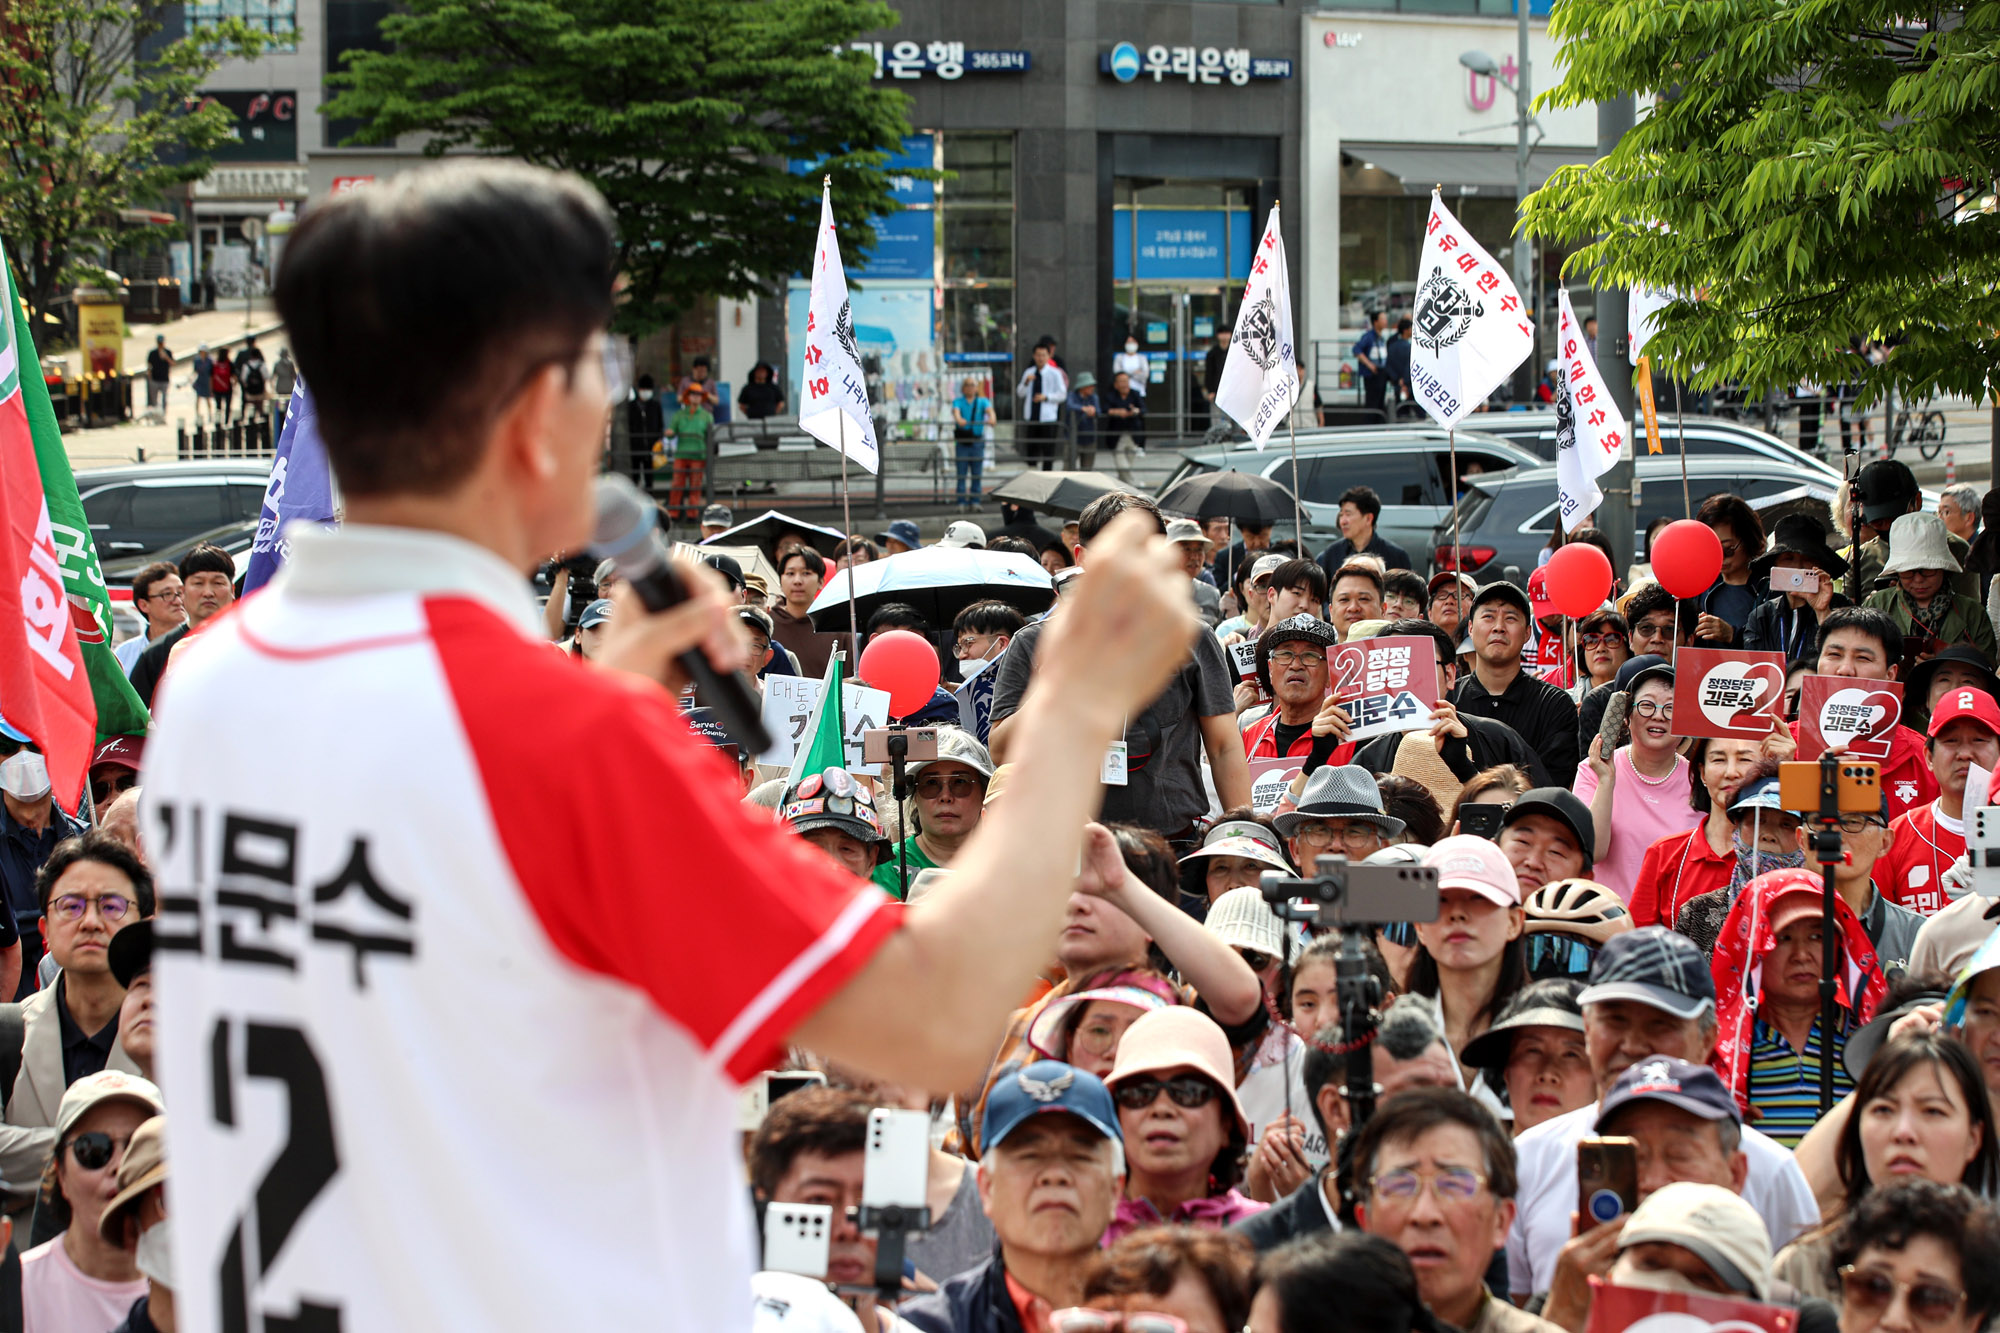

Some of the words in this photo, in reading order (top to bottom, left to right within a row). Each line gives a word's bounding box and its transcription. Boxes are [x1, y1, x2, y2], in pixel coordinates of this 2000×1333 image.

[1144, 44, 1250, 86] 우리은행
[1410, 360, 1461, 418] 라사랑모임
[1367, 646, 1411, 670] 정정
[1335, 647, 1365, 699] 2
[1366, 667, 1410, 692] 당당
[1707, 677, 1756, 692] 정정당당
[1703, 690, 1754, 708] 김문수
[1728, 662, 1785, 732] 2
[1957, 691, 1974, 710] 2
[1337, 691, 1417, 730] 김문수
[1827, 704, 1873, 718] 정정당당
[689, 720, 715, 730] Serve
[1823, 716, 1872, 734] 김문수
[1254, 781, 1288, 795] 정정당당
[209, 1014, 345, 1333] 2
